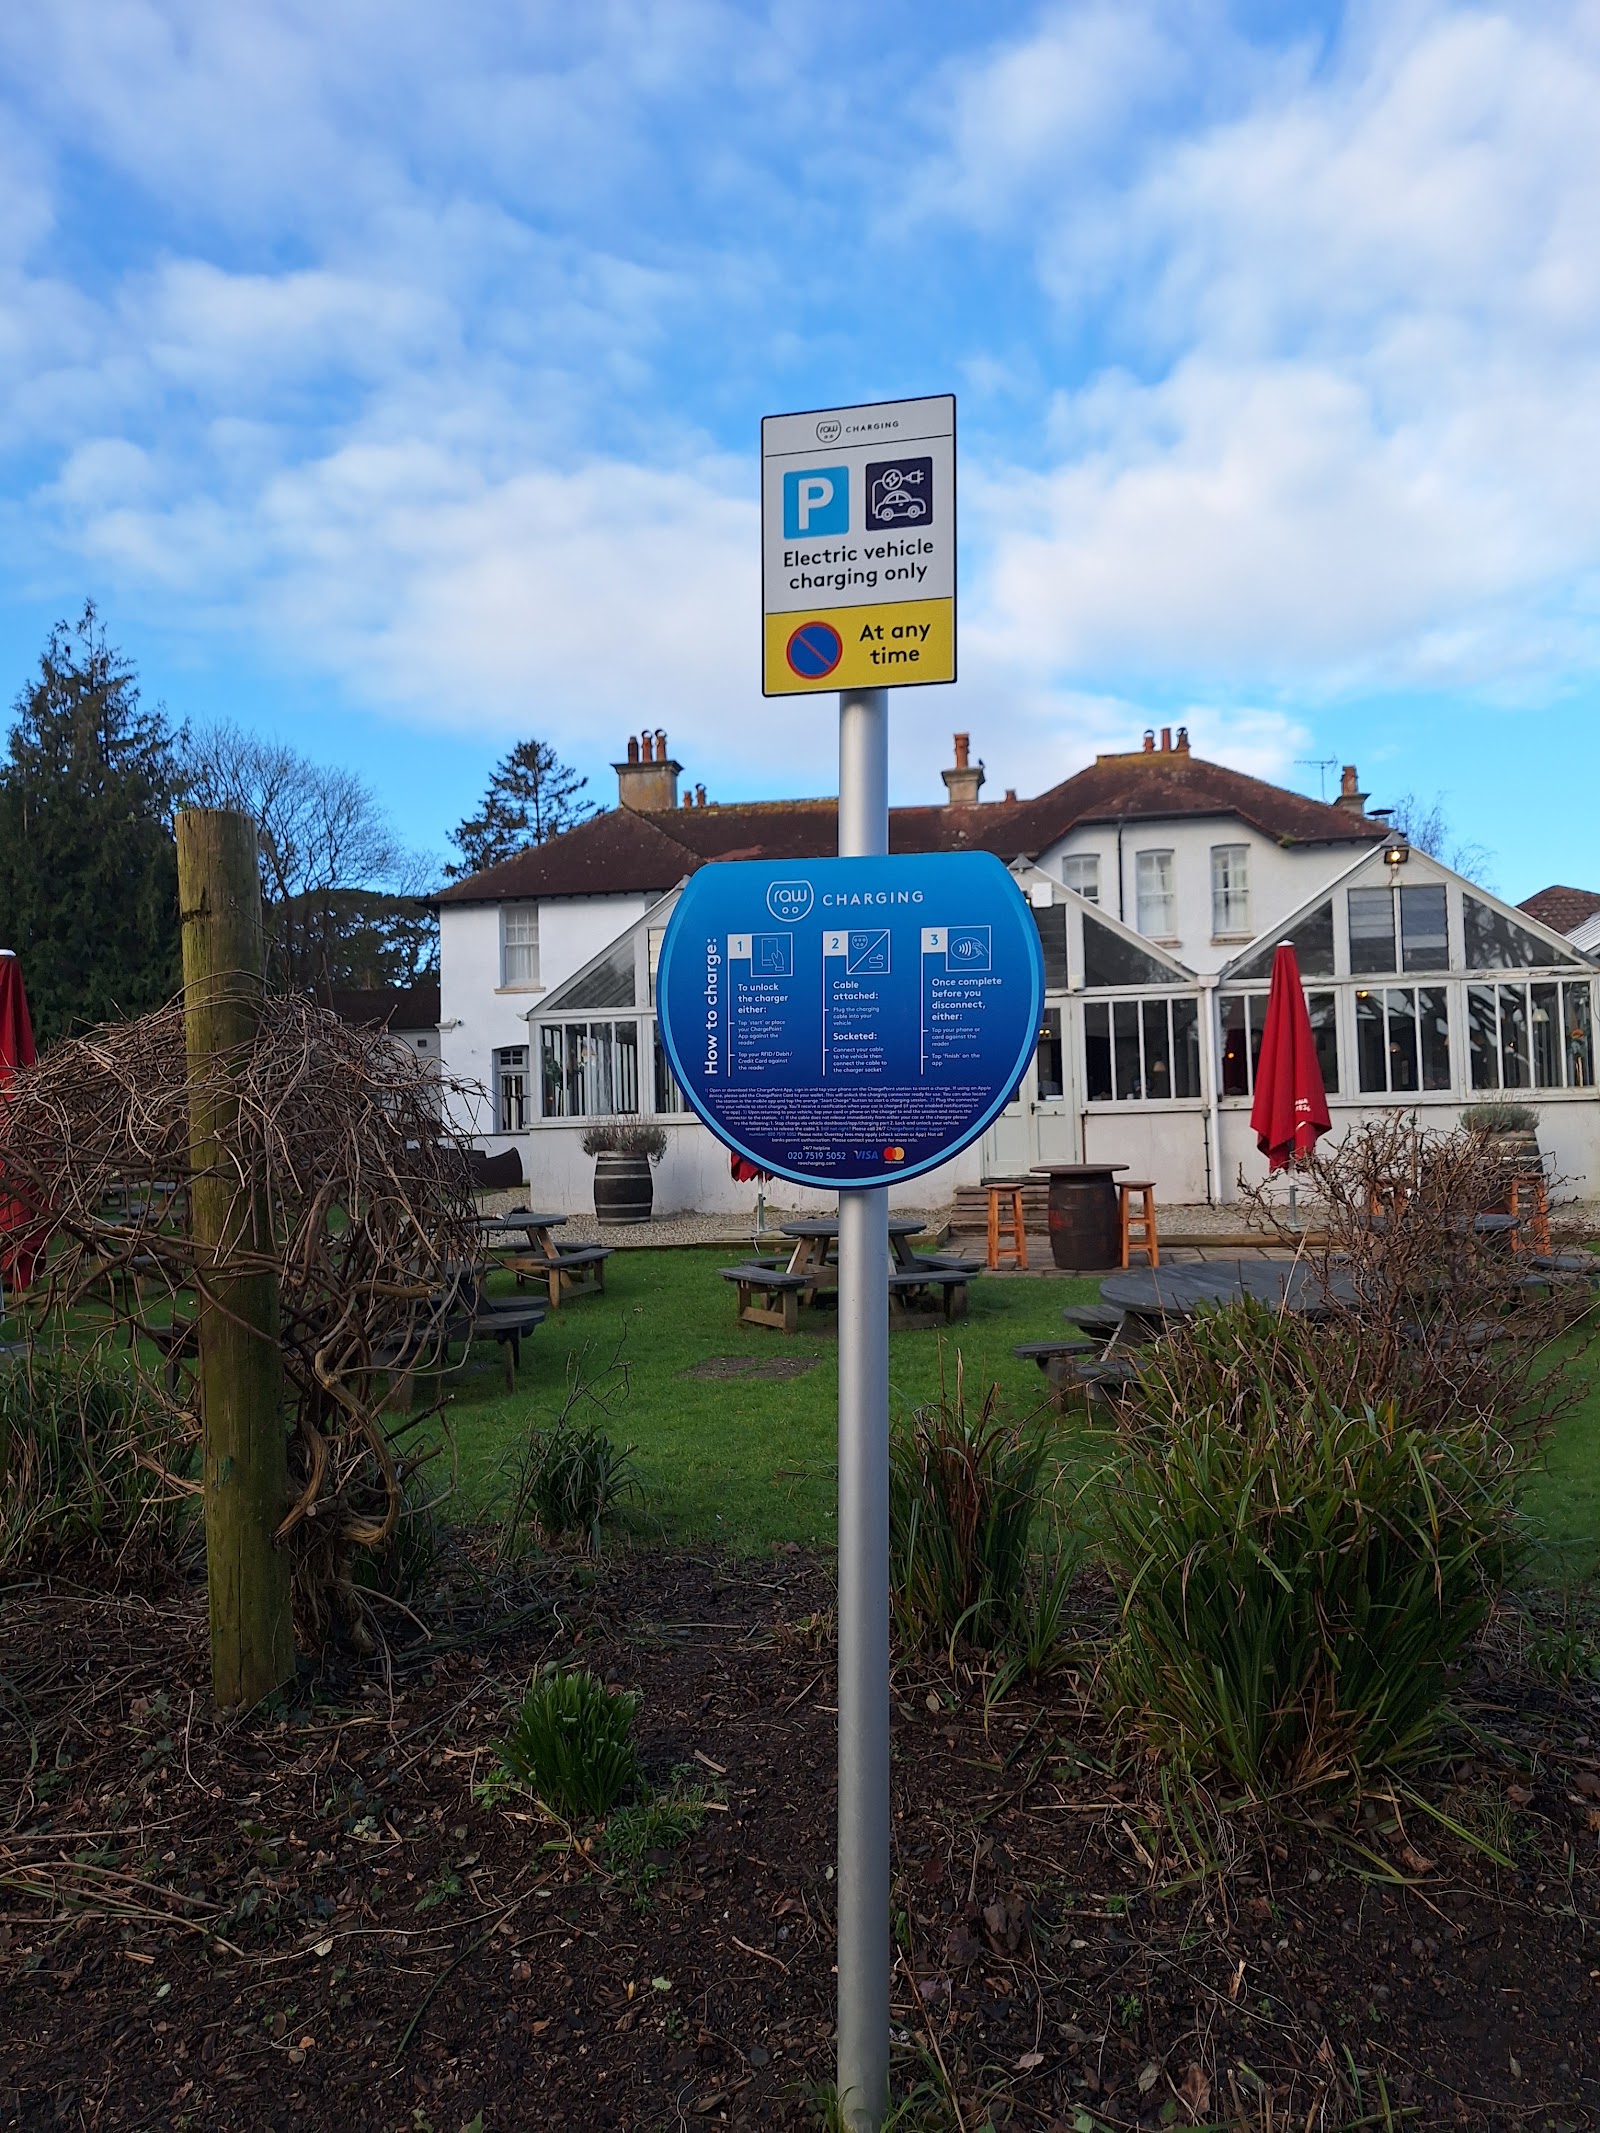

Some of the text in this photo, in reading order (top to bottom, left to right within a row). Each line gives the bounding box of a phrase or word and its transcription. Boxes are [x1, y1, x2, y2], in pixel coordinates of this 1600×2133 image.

[820, 420, 900, 434] raw CHARGING
[798, 477, 834, 530] P
[784, 538, 934, 567] Electric vehicle
[790, 562, 928, 590] charging only
[860, 624, 930, 642] At any
[870, 647, 920, 665] time
[774, 890, 923, 906] raw CHARGING
[738, 941, 742, 952] 1
[832, 938, 839, 949] 2
[930, 934, 938, 946] 3
[750, 983, 778, 991] unlock
[704, 938, 721, 1074] How to charge:
[755, 995, 787, 1003] charger
[854, 1150, 878, 1158] VISA
